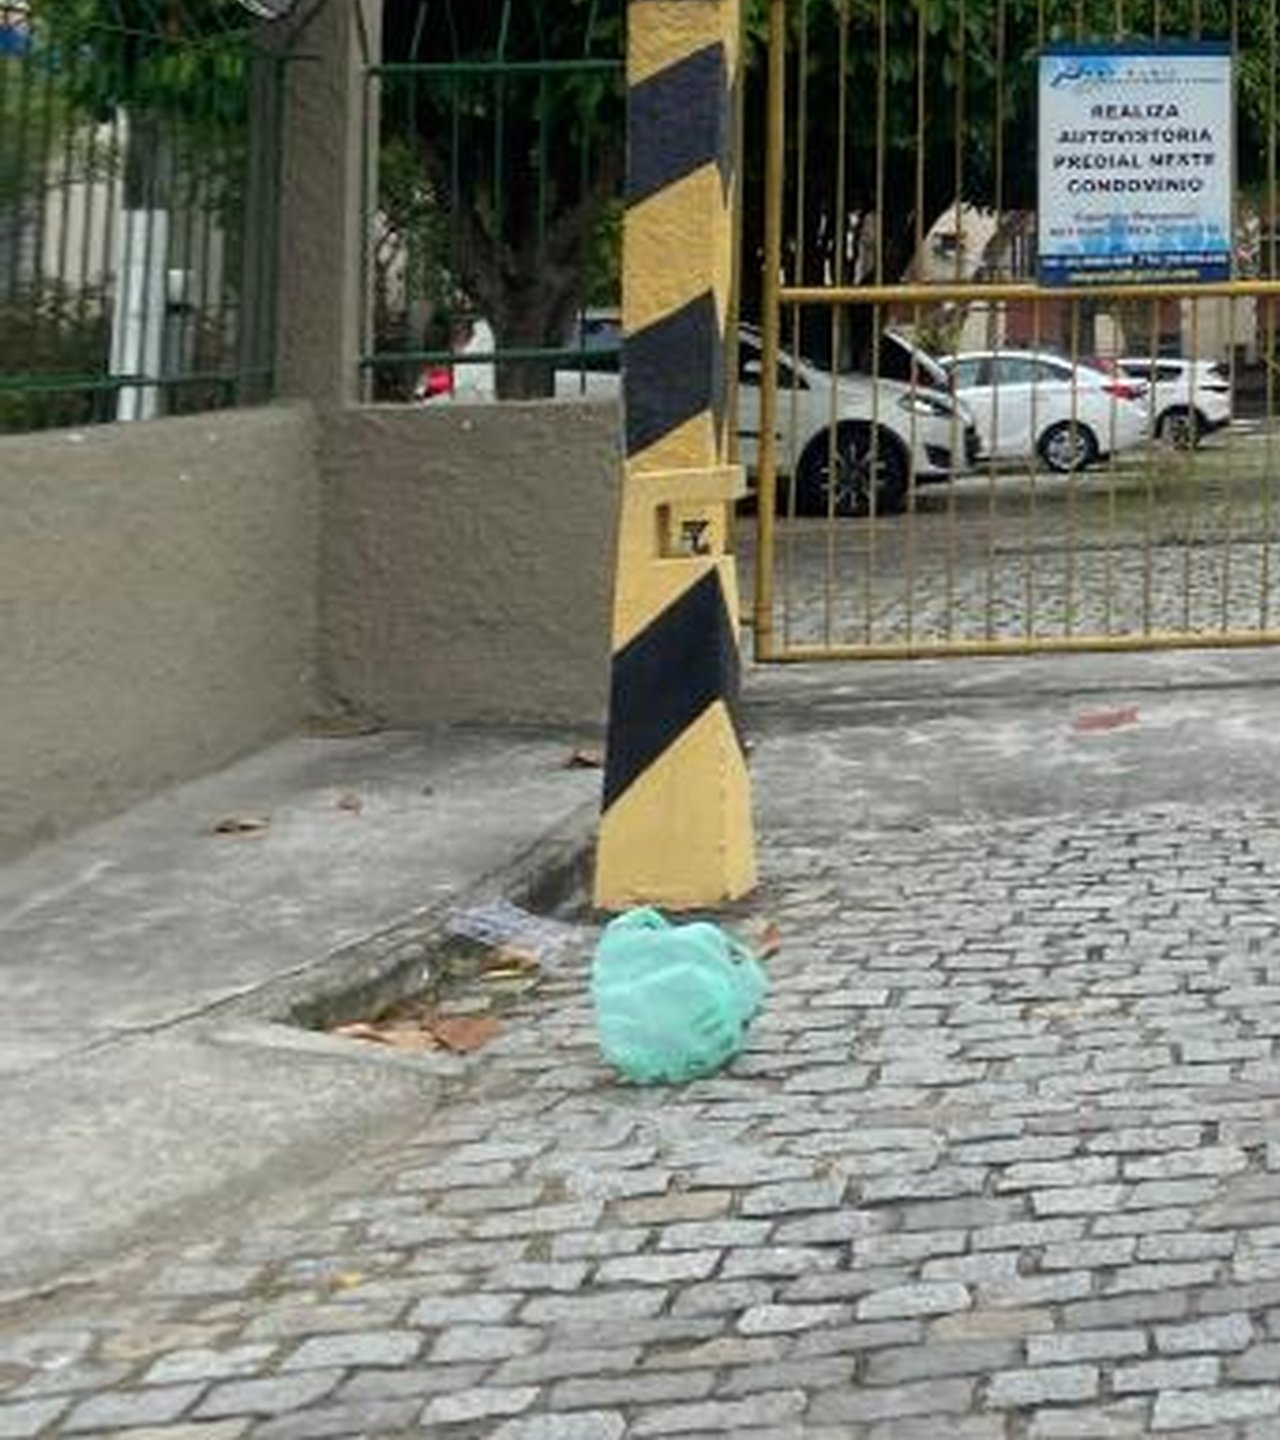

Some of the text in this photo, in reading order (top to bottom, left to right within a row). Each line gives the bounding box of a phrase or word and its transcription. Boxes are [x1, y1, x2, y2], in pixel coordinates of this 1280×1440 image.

[1090, 103, 1180, 119] REALIZA
[1058, 128, 1213, 144] AUTOVISTORIA
[1053, 152, 1216, 170] PREDIAL NESTE
